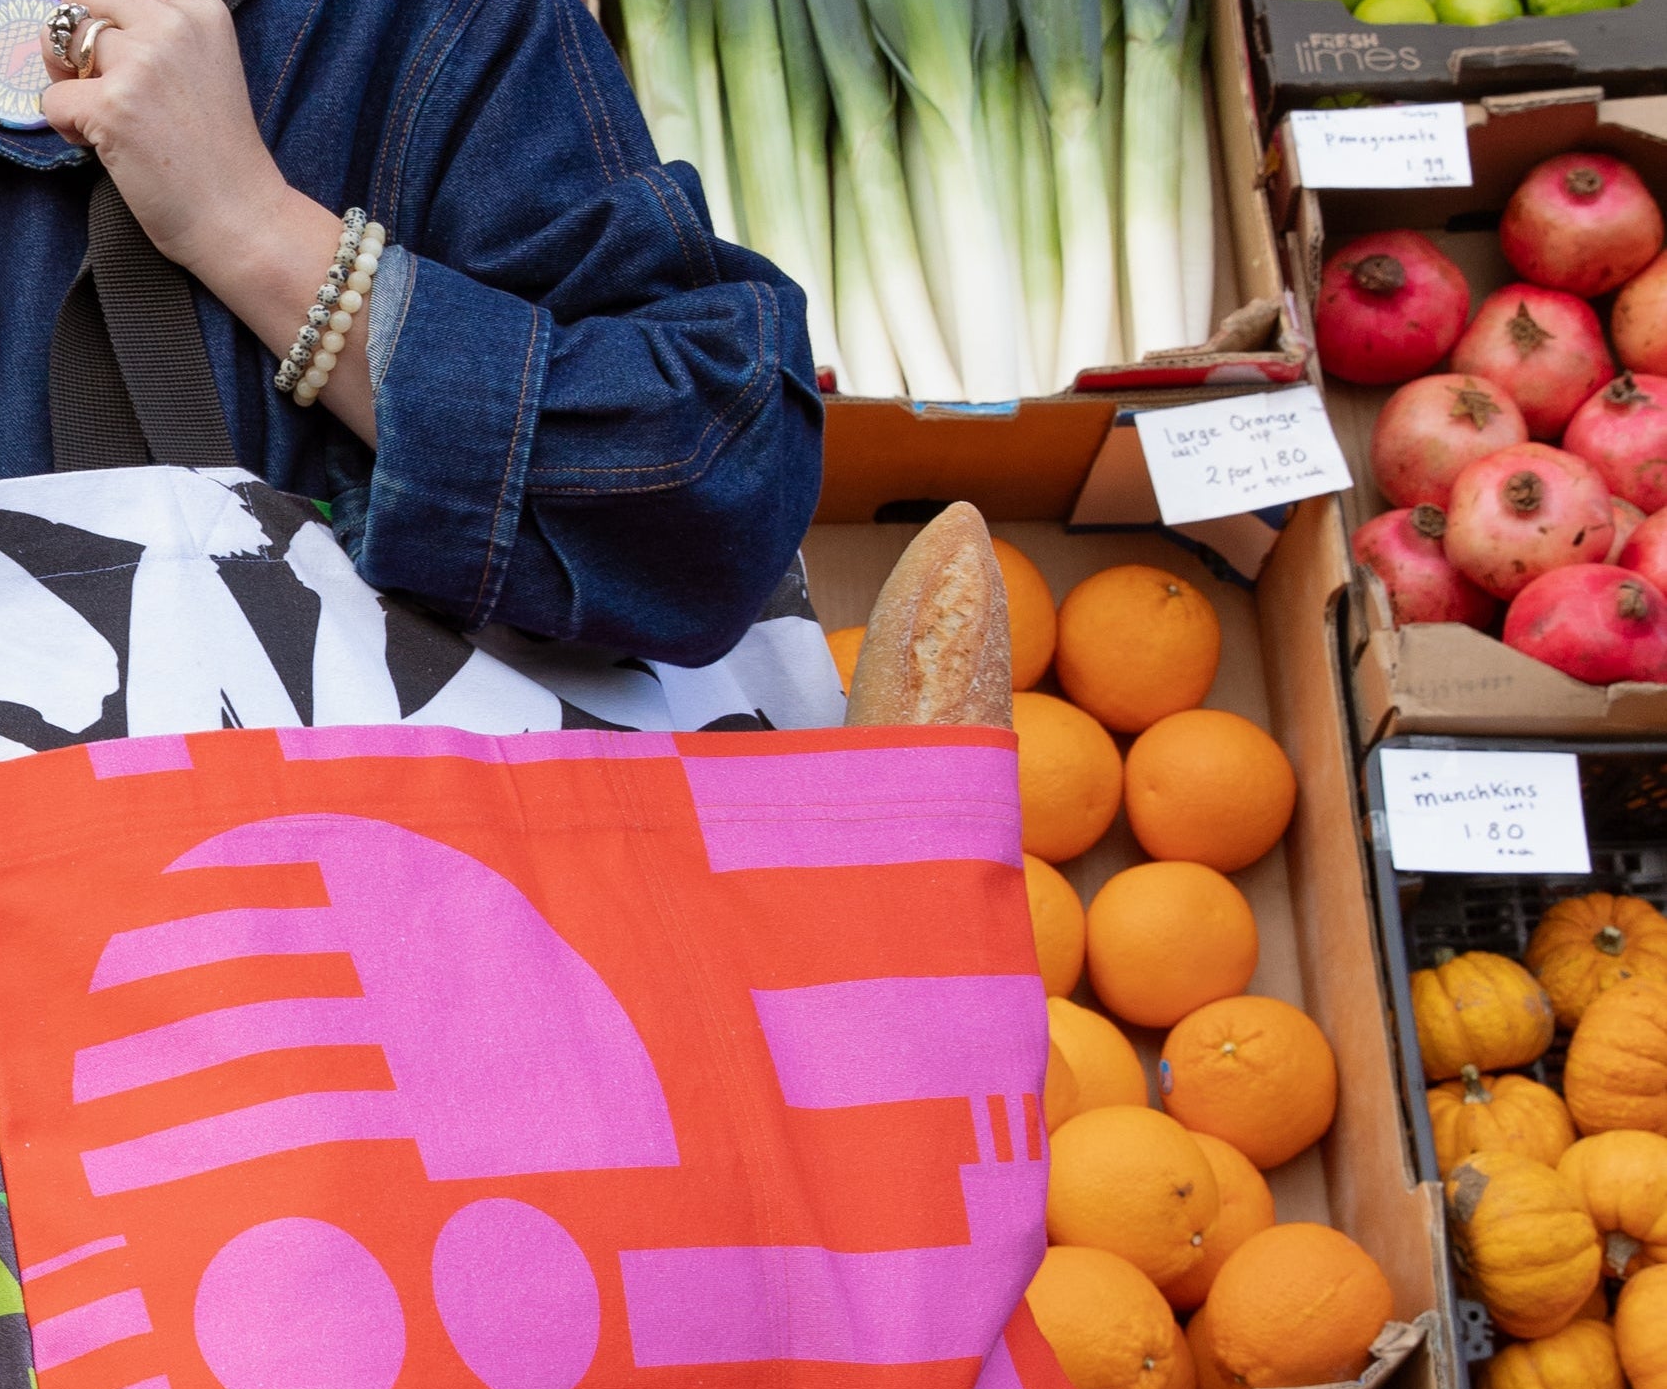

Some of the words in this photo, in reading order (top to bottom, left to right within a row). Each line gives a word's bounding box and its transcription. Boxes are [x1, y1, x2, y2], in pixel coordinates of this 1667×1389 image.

[1309, 32, 1379, 48] FRESH
[1294, 42, 1422, 74] limes
[1229, 412, 1301, 432] Orange
[1205, 466, 1222, 484] 2
